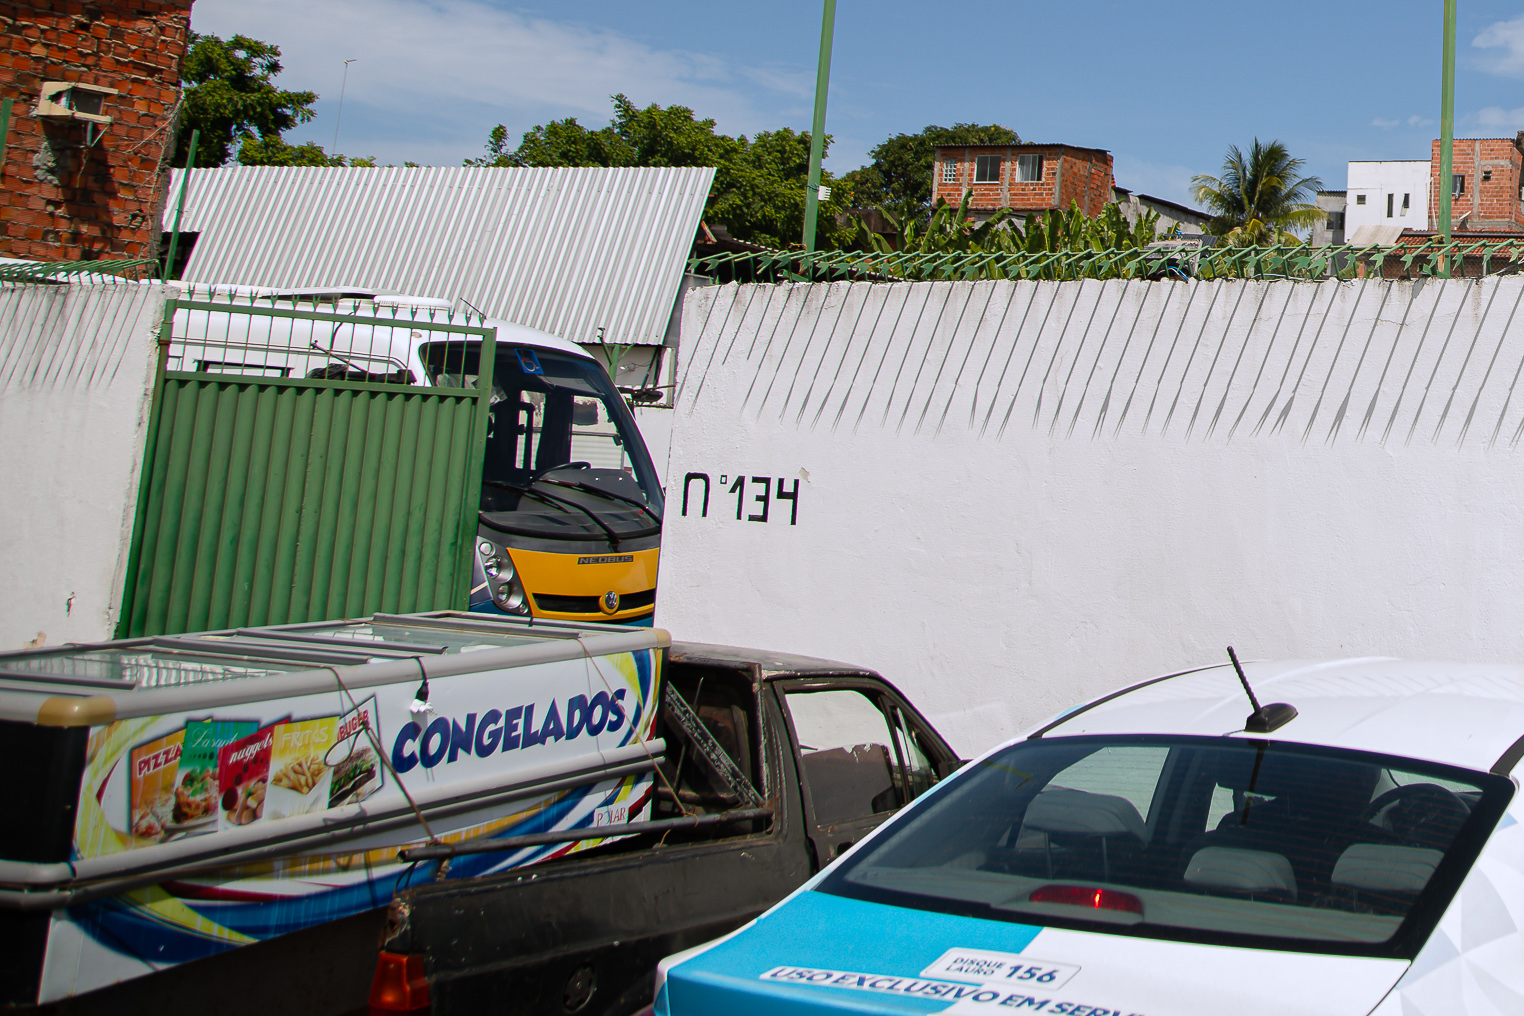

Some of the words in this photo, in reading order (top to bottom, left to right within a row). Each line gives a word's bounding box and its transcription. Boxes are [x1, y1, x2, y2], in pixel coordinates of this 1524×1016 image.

[579, 555, 633, 564] NEOBUS
[391, 687, 627, 774] CONGELADOS
[138, 742, 183, 777] PIZZA
[945, 965, 995, 976] LAURO
[953, 957, 1006, 969] DISQUE
[1006, 964, 1060, 983] 156
[770, 968, 833, 982] USO
[831, 973, 1000, 1002] EXCLUSIVO
[998, 993, 1052, 1011] EM
